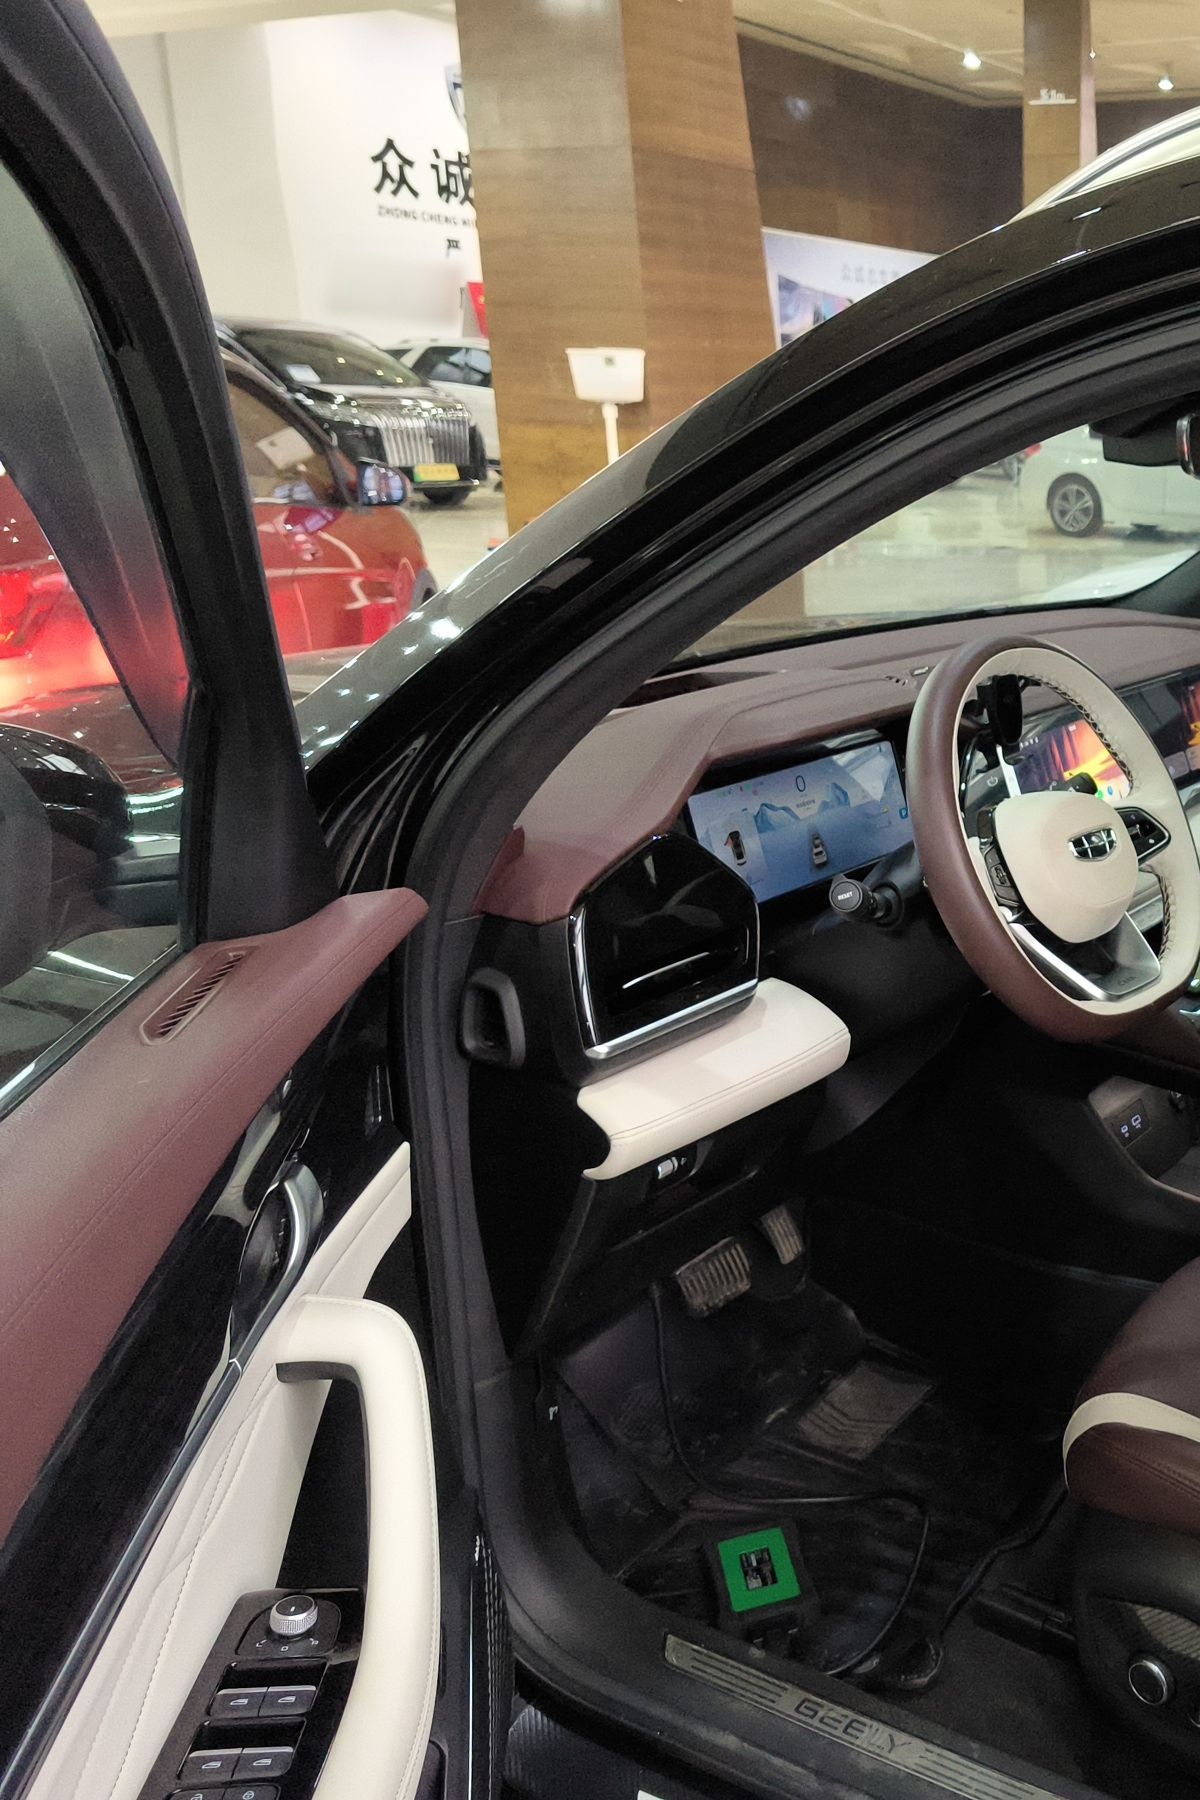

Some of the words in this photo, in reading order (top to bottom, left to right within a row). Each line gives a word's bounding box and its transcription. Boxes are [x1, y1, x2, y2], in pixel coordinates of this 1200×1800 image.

[371, 138, 475, 205] 众诚
[795, 775, 806, 792] 0
[837, 891, 853, 901] RESET
[794, 1697, 912, 1754] GEELY
